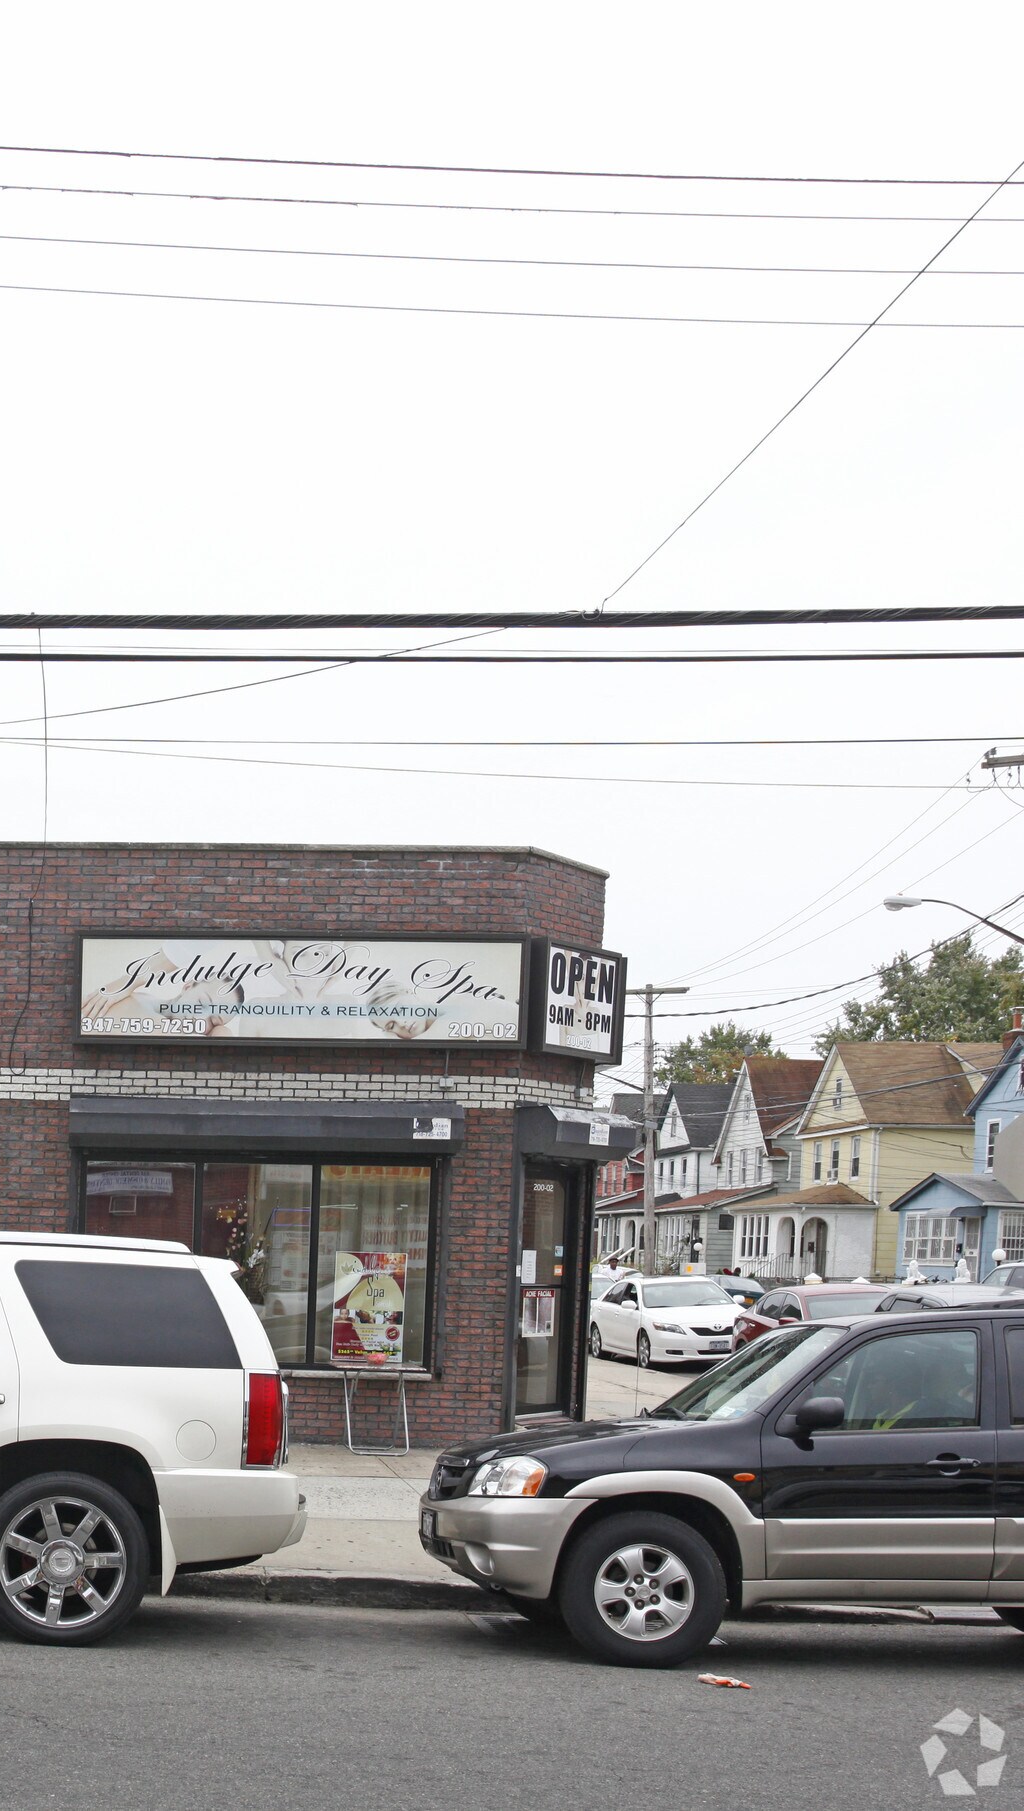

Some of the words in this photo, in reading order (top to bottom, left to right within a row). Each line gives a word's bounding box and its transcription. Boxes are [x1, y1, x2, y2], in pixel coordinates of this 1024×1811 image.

[100, 951, 273, 996] Indulge
[287, 943, 394, 996] Day
[411, 959, 506, 1004] Spa
[550, 952, 615, 1004] OPEN
[159, 1004, 203, 1014] PURE
[209, 1004, 316, 1016] TRANQUILITY
[320, 1006, 330, 1016] &
[337, 1006, 438, 1018] RELAXATION
[549, 1004, 574, 1027] 9AM
[585, 1011, 611, 1034] 8PM
[81, 1017, 207, 1035] 347-759-7250
[448, 1022, 517, 1039] 200-02
[566, 1035, 592, 1050] 200-02
[533, 1183, 553, 1192] 200-02
[366, 1275, 385, 1306] Spa
[538, 1290, 552, 1298] FACIAL
